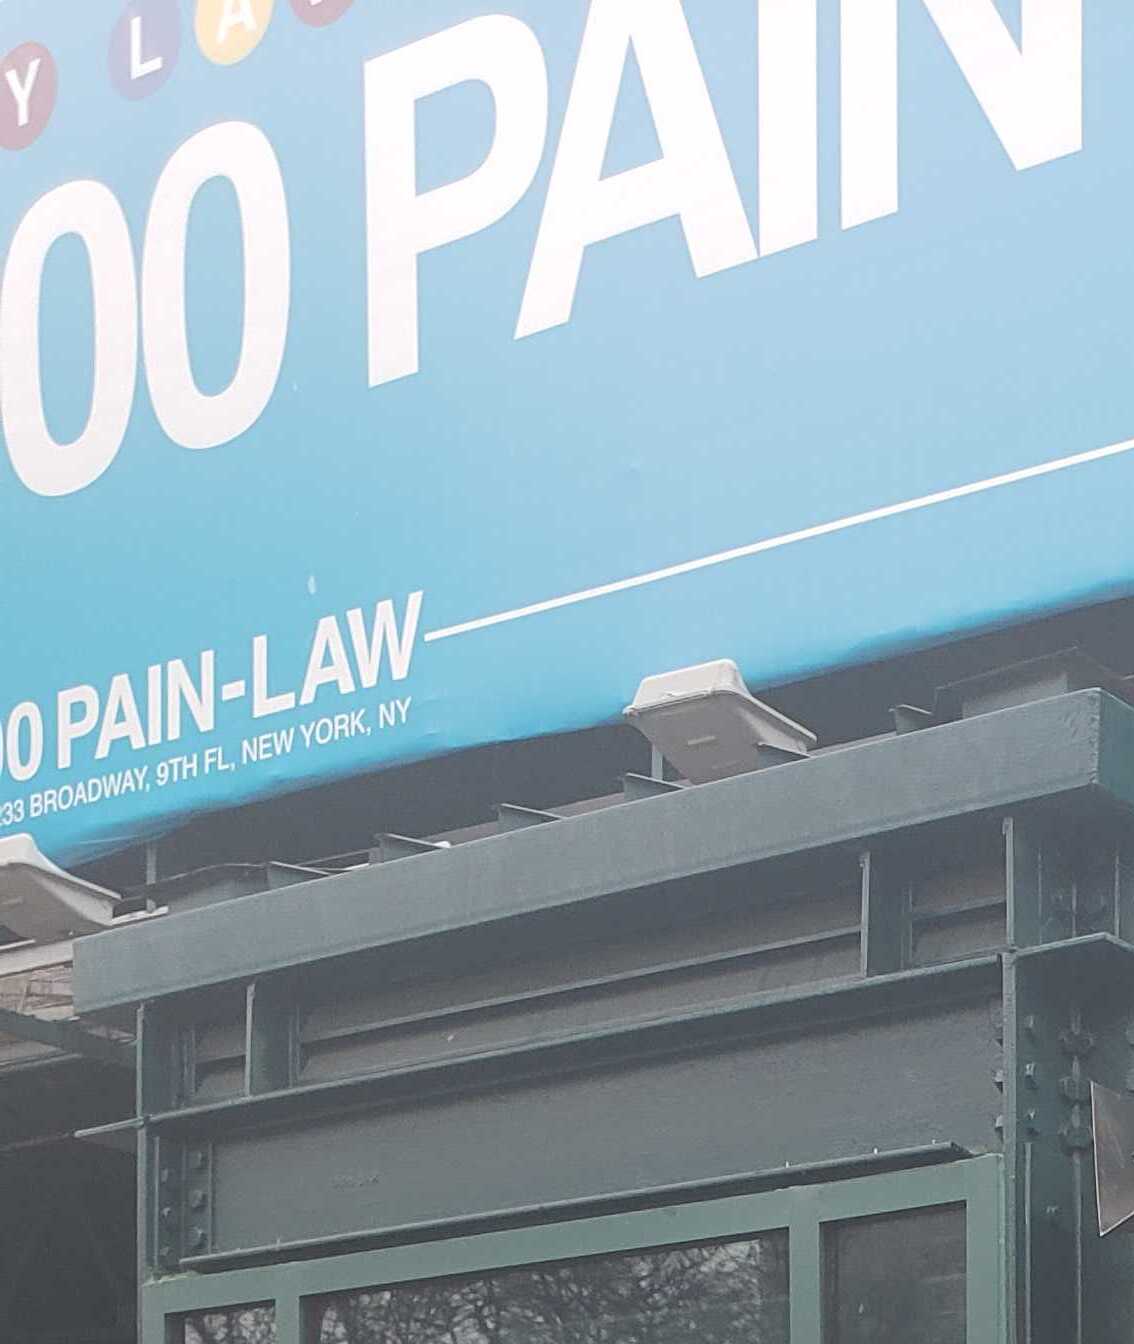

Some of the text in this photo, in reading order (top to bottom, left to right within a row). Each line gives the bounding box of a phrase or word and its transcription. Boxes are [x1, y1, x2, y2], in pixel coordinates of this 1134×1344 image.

[56, 590, 424, 770] PAIN-LAW
[30, 767, 151, 819] BROADWAY,
[156, 748, 198, 785] 9TH
[204, 743, 237, 775] FL,
[241, 727, 295, 767] NEW
[302, 712, 372, 749] YORK,
[379, 697, 412, 728] NY
